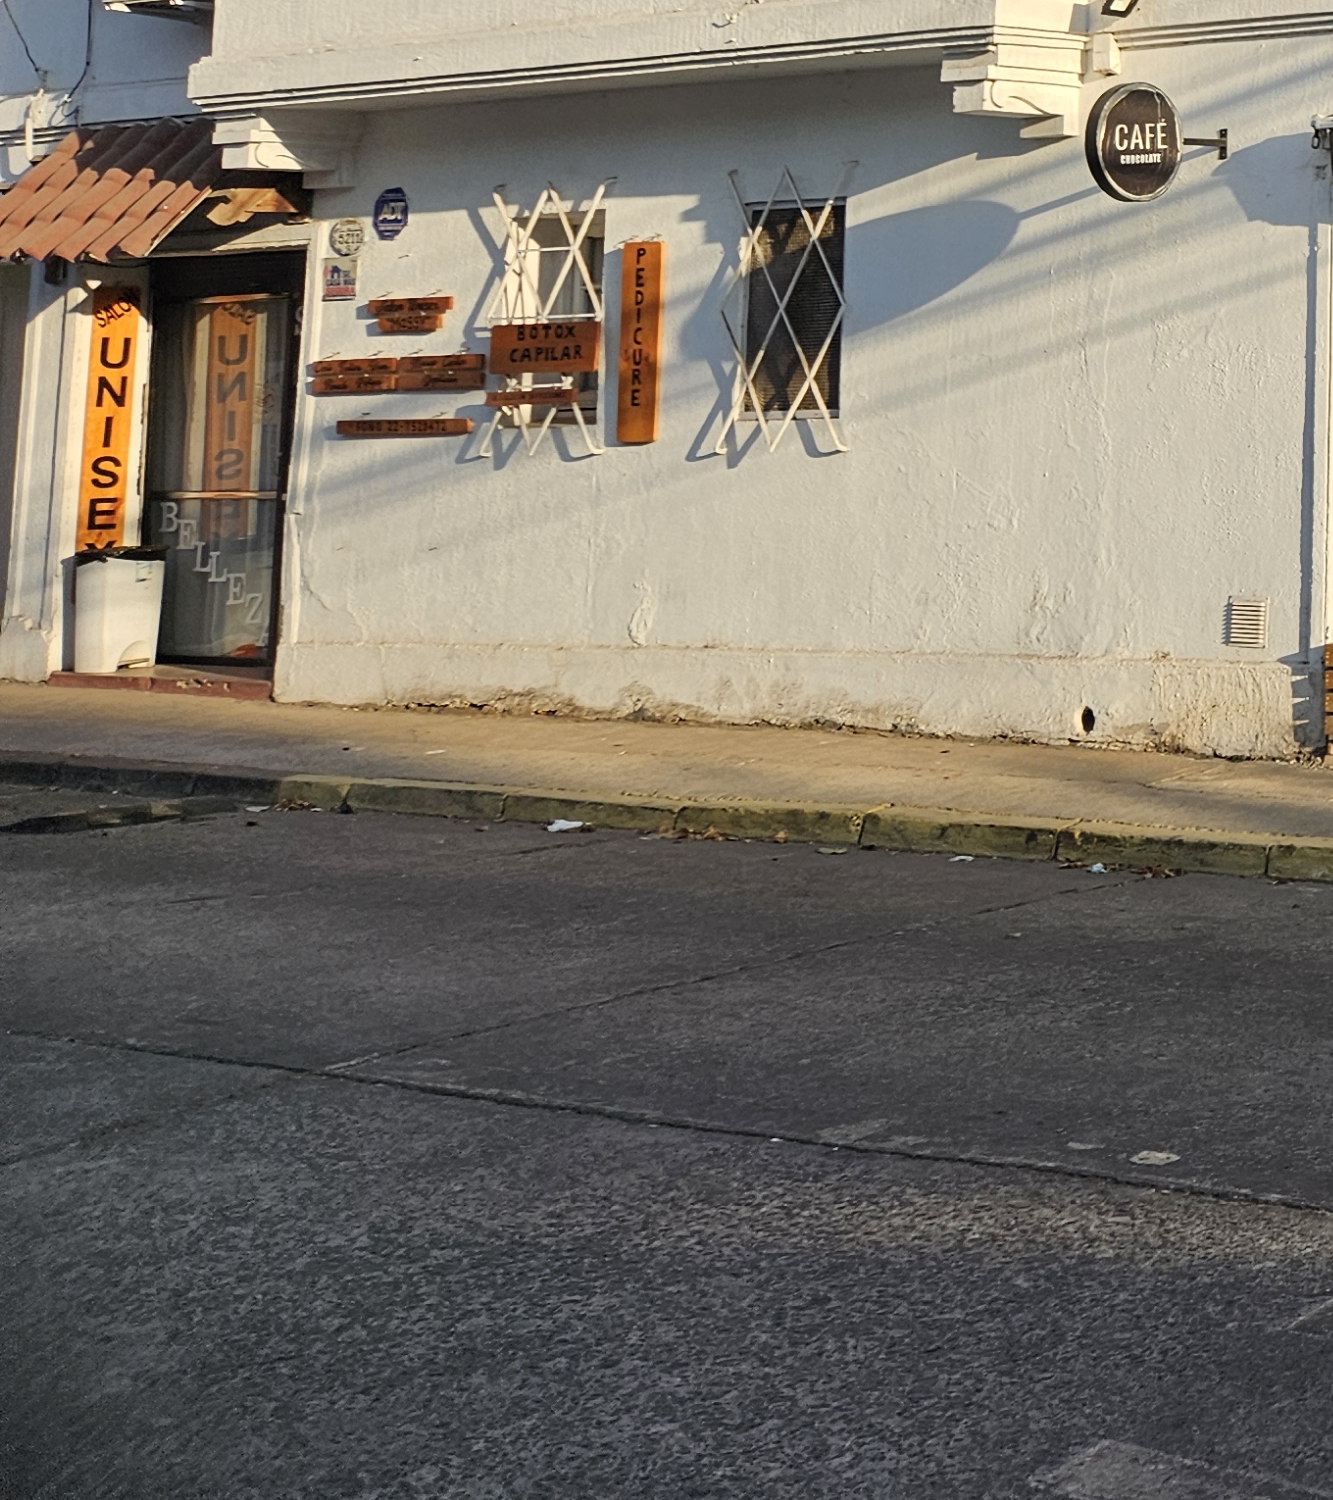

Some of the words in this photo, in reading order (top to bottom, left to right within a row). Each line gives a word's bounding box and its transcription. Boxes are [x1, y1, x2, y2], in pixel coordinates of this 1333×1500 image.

[1114, 118, 1168, 150] CAFÉ
[1120, 153, 1162, 165] CHOCOLATE
[516, 325, 576, 341] BOTOX
[630, 247, 647, 408] PEDICURE
[509, 344, 584, 363] CAPILAR
